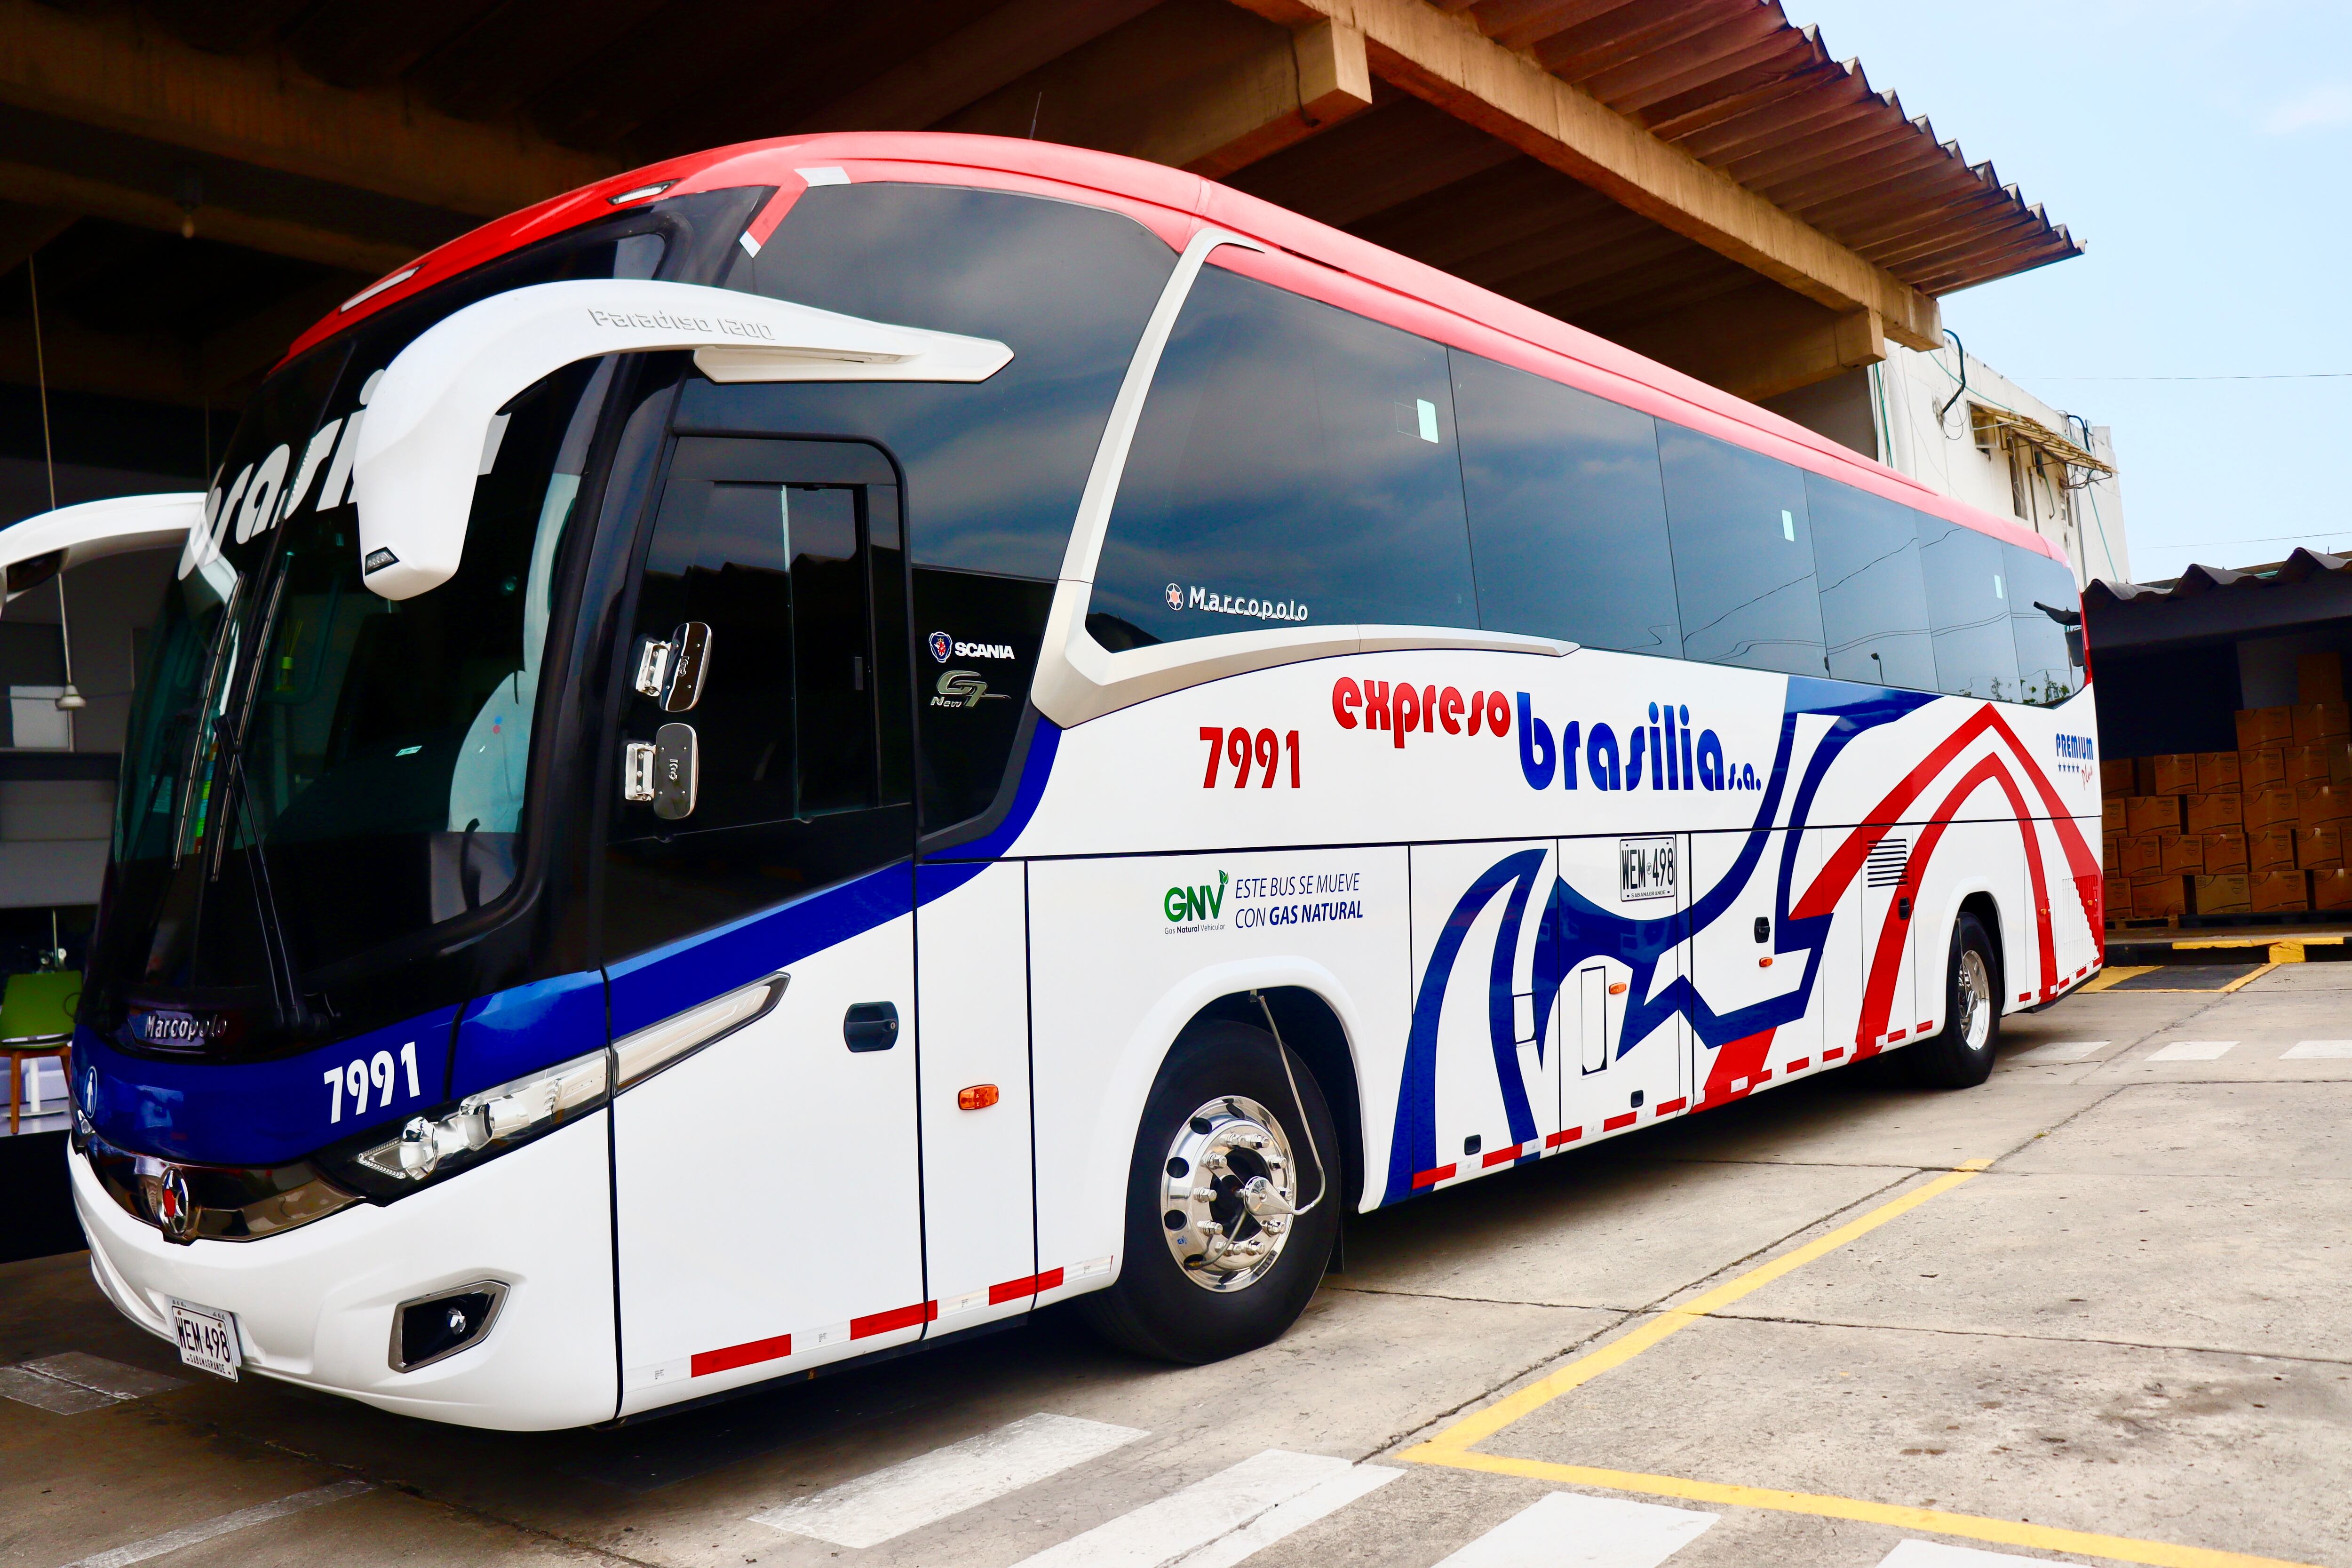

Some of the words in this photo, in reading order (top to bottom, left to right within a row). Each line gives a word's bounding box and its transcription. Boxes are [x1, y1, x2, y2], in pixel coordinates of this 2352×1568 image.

[588, 308, 713, 332] Paradiso
[716, 318, 776, 341] 1200
[1188, 585, 1309, 621] Marcopolo
[954, 642, 1015, 660] SCANIA
[930, 696, 962, 708] New
[1332, 677, 1511, 749] expreso
[1516, 691, 1725, 791] brasilia
[1728, 763, 1761, 791] s.a.
[2056, 732, 2094, 760] PREMIUM
[1200, 727, 1300, 788] 7991
[1621, 849, 1646, 890] WEM
[1653, 848, 1674, 886] 498
[1235, 878, 1267, 899] ESTE
[1270, 876, 1295, 897] BUS
[1299, 875, 1313, 895] SE
[1316, 873, 1360, 893] MUEVE
[1631, 890, 1666, 898] SABANAGRANDE
[1164, 884, 1225, 923] GNV
[1235, 907, 1266, 928] CON
[1270, 905, 1298, 926] GAS
[1302, 900, 1363, 923] NATURAL
[1176, 924, 1200, 934] Natural
[1200, 923, 1225, 932] Vehicular
[145, 1013, 228, 1041] Marcopolo
[324, 1041, 421, 1124] 7991
[175, 1316, 204, 1354] WEM
[205, 1325, 230, 1363] 498
[190, 1353, 226, 1374] SABANAGRANDE
